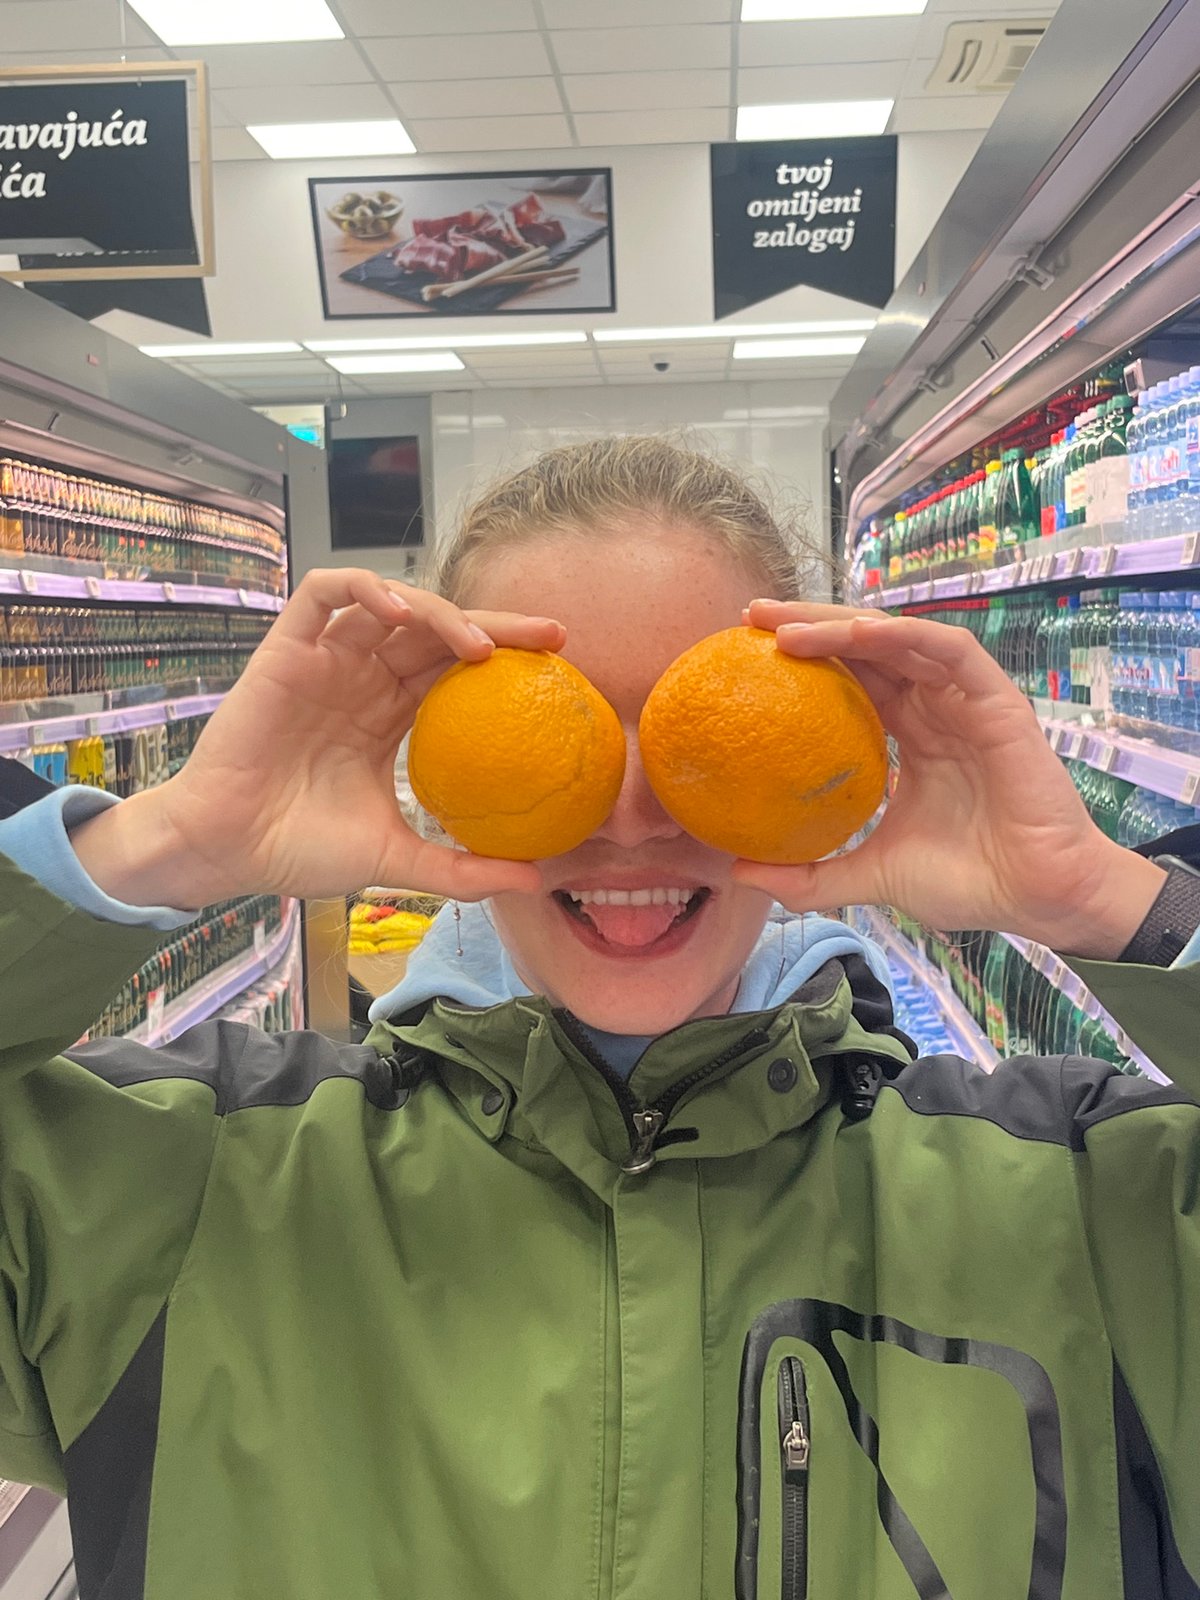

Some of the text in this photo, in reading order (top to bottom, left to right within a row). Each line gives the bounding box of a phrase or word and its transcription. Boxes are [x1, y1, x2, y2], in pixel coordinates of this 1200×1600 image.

[0, 109, 147, 160] avajuća
[0, 162, 46, 199] ća
[776, 158, 833, 191] tvoj
[747, 188, 862, 222] omiljeni
[753, 220, 855, 253] zalogaj
